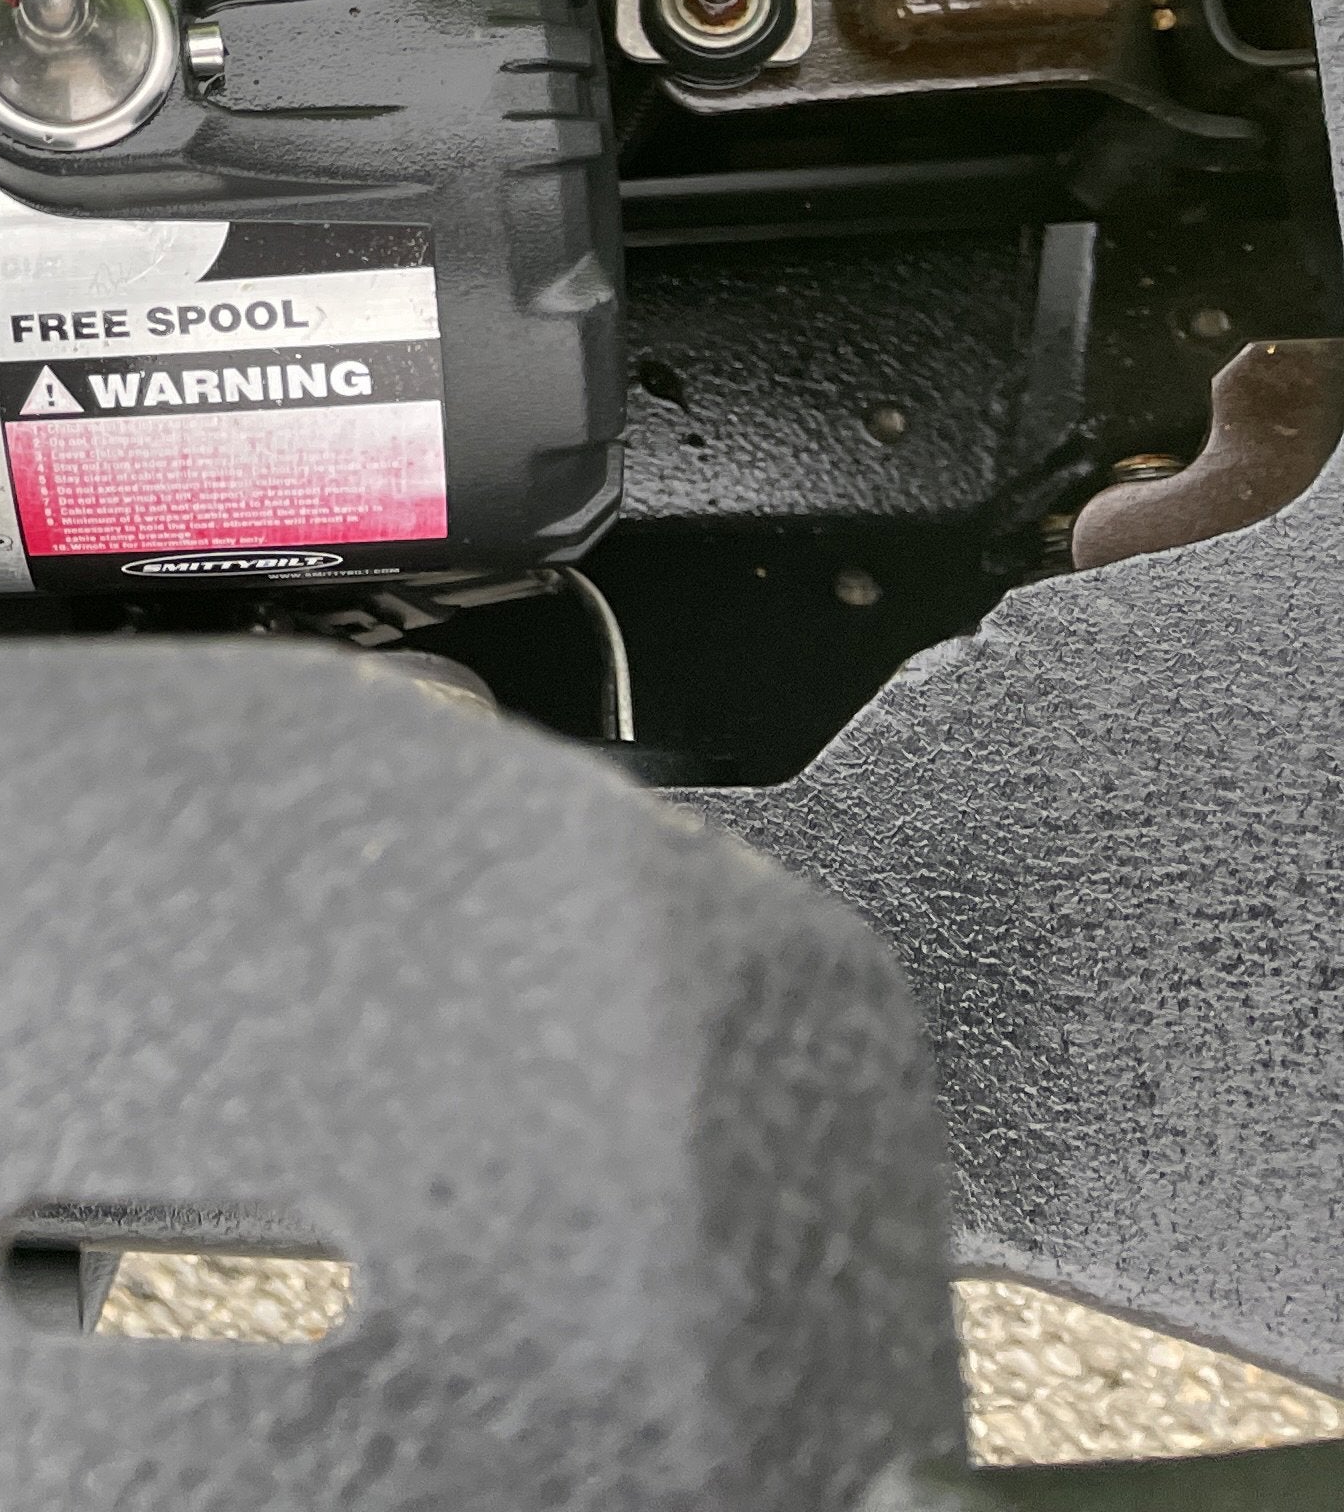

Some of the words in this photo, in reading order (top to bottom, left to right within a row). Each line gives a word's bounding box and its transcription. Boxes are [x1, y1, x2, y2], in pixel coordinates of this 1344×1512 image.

[10, 309, 130, 343] FREE
[147, 300, 309, 335] SPOOL
[88, 360, 372, 410] WARNING
[52, 462, 79, 474] Stay
[53, 475, 81, 486] Stay
[83, 473, 111, 482] clear
[130, 471, 163, 479] cable
[56, 486, 72, 494] Do
[75, 485, 94, 493] not
[97, 482, 138, 492] exceed
[141, 480, 200, 490] maximum
[57, 496, 74, 505] Do
[77, 495, 96, 504] not
[122, 492, 157, 502] winch
[160, 492, 172, 500] to
[266, 485, 321, 498] transport
[59, 506, 93, 515] Cable
[95, 504, 132, 516] clamp
[134, 503, 146, 511] is
[192, 499, 246, 511] designed
[249, 498, 261, 506] to
[263, 497, 290, 505] hold
[61, 515, 116, 524] Minimum
[118, 514, 130, 522] of
[143, 514, 180, 523] wraps
[196, 510, 229, 518] cable
[232, 508, 273, 517] around
[276, 507, 295, 515] the
[298, 506, 329, 514] drum
[332, 504, 369, 512] barrel
[63, 526, 121, 536] necessary
[222, 518, 281, 526] otherwise
[70, 542, 106, 550] Winch
[141, 538, 208, 546] intermittent
[211, 536, 236, 546] duty
[99, 534, 136, 542] clamp
[141, 557, 324, 574] SMITTYBILT
[268, 567, 401, 580] WWW.SMITTYBILT.COM
